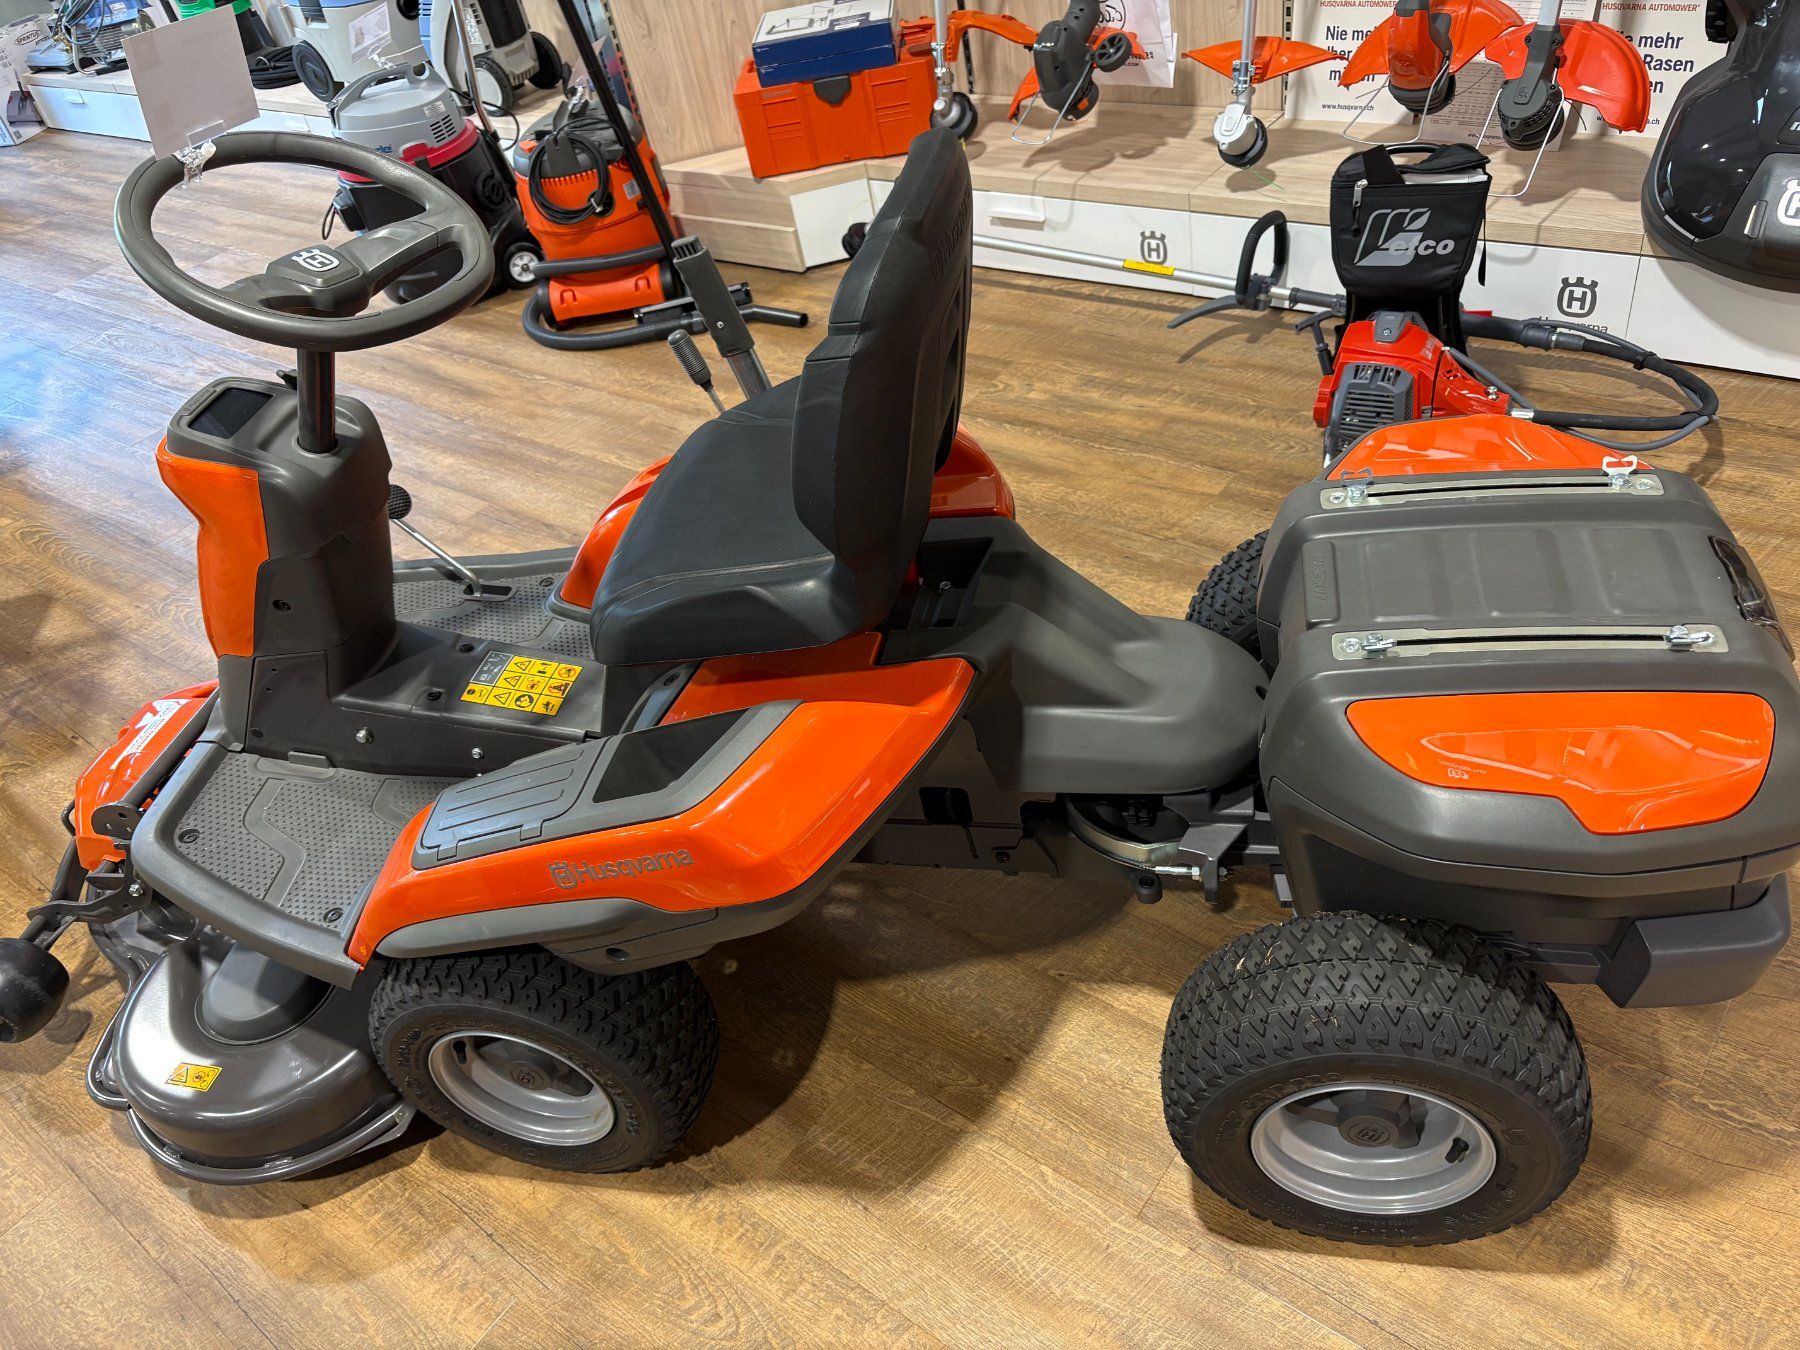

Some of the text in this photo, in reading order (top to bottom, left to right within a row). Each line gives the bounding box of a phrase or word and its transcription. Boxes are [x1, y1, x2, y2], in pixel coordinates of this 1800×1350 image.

[1320, 0, 1358, 8] HUSQVARNA
[1602, 2, 1647, 11] HUSQVARNA
[1325, 25, 1348, 41] Nie
[1637, 31, 1684, 49] mehr
[1643, 54, 1695, 73] Rasen
[571, 848, 695, 883] Husqvarna
